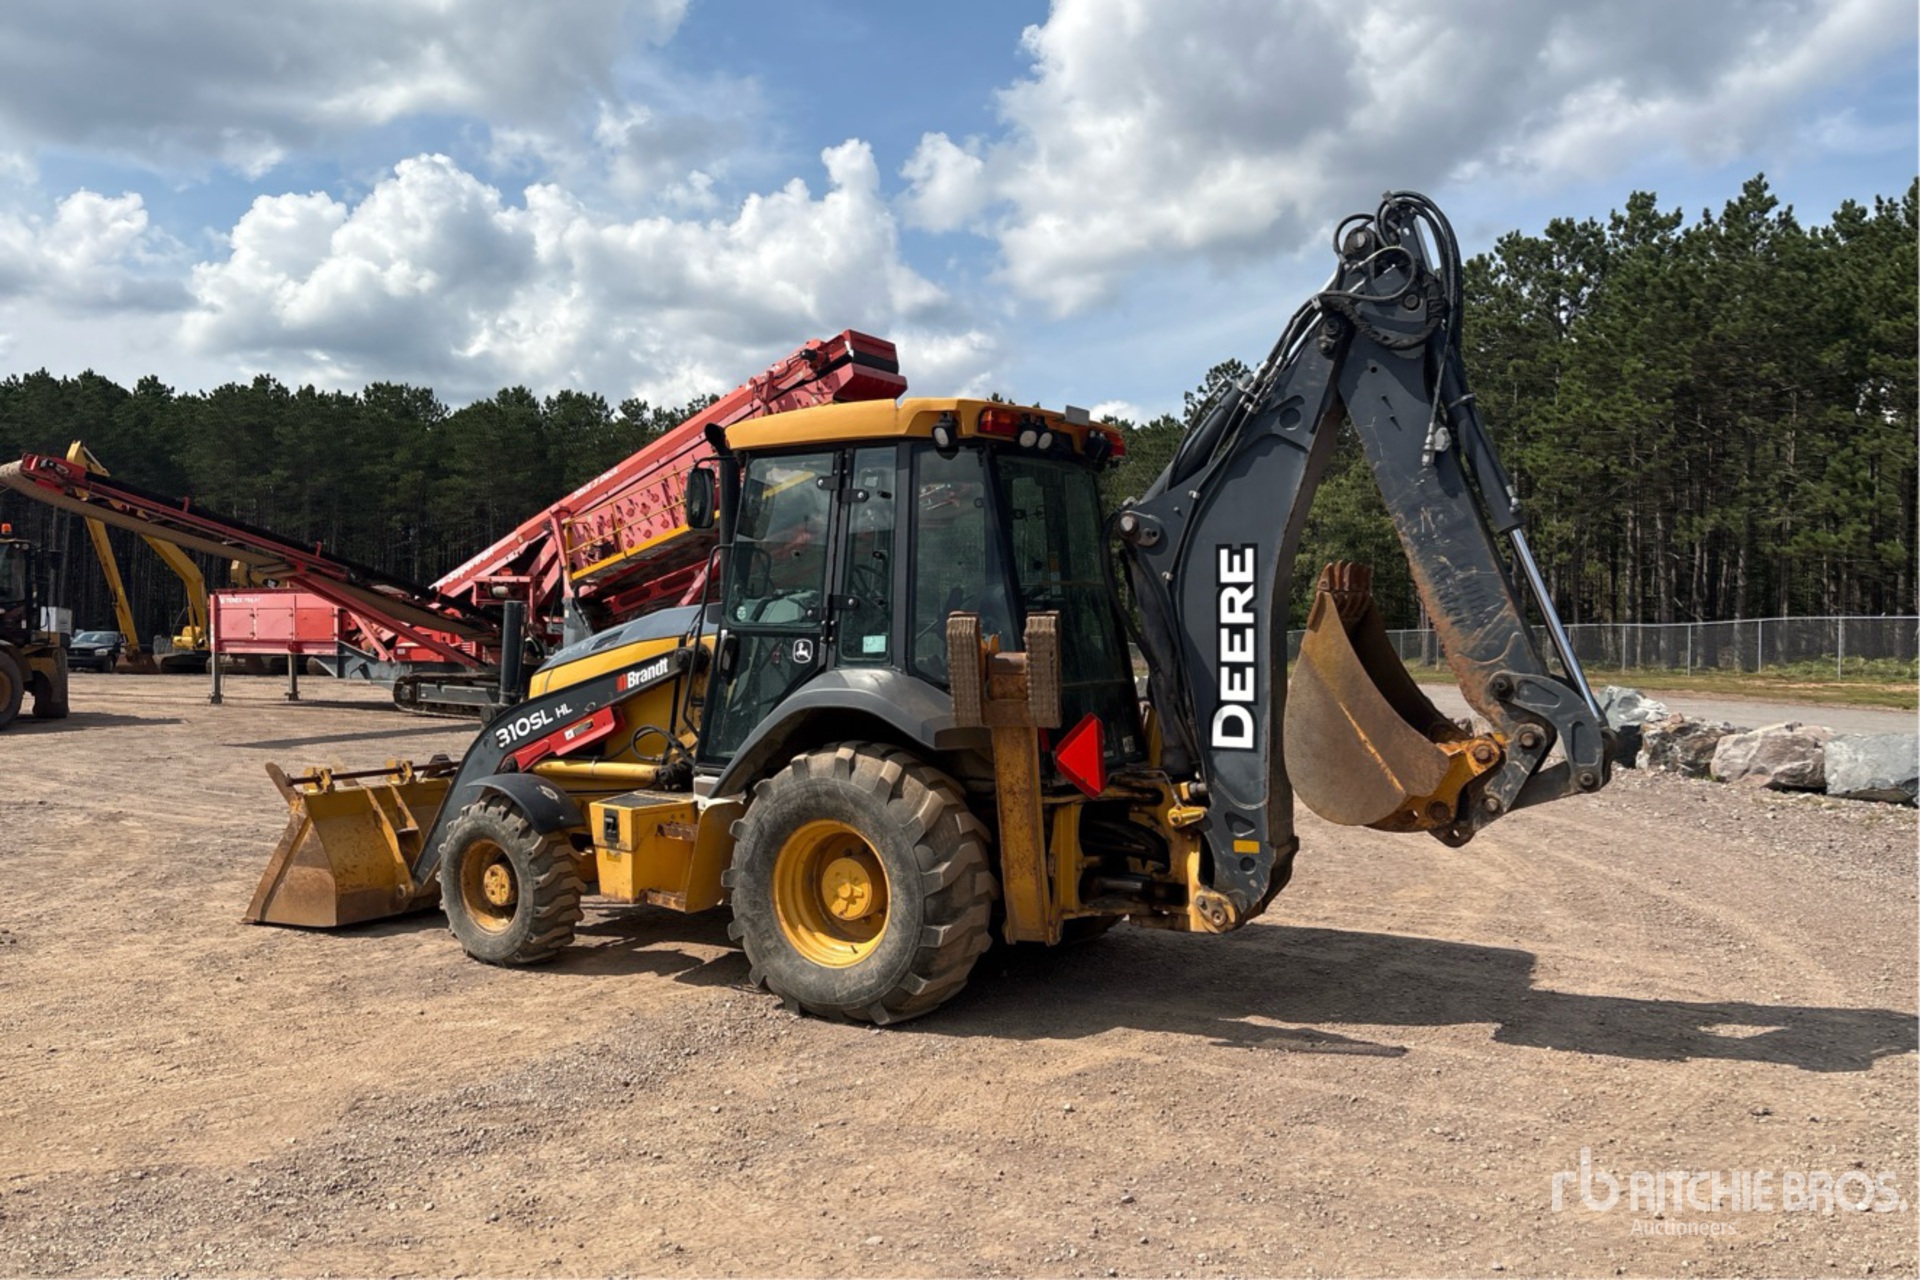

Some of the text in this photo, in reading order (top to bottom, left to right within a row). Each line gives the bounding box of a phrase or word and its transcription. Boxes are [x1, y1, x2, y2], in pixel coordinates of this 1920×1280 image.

[1211, 547, 1255, 749] DEERE
[626, 657, 669, 689] Brandt
[495, 709, 554, 749] 310SL
[555, 703, 573, 719] HL
